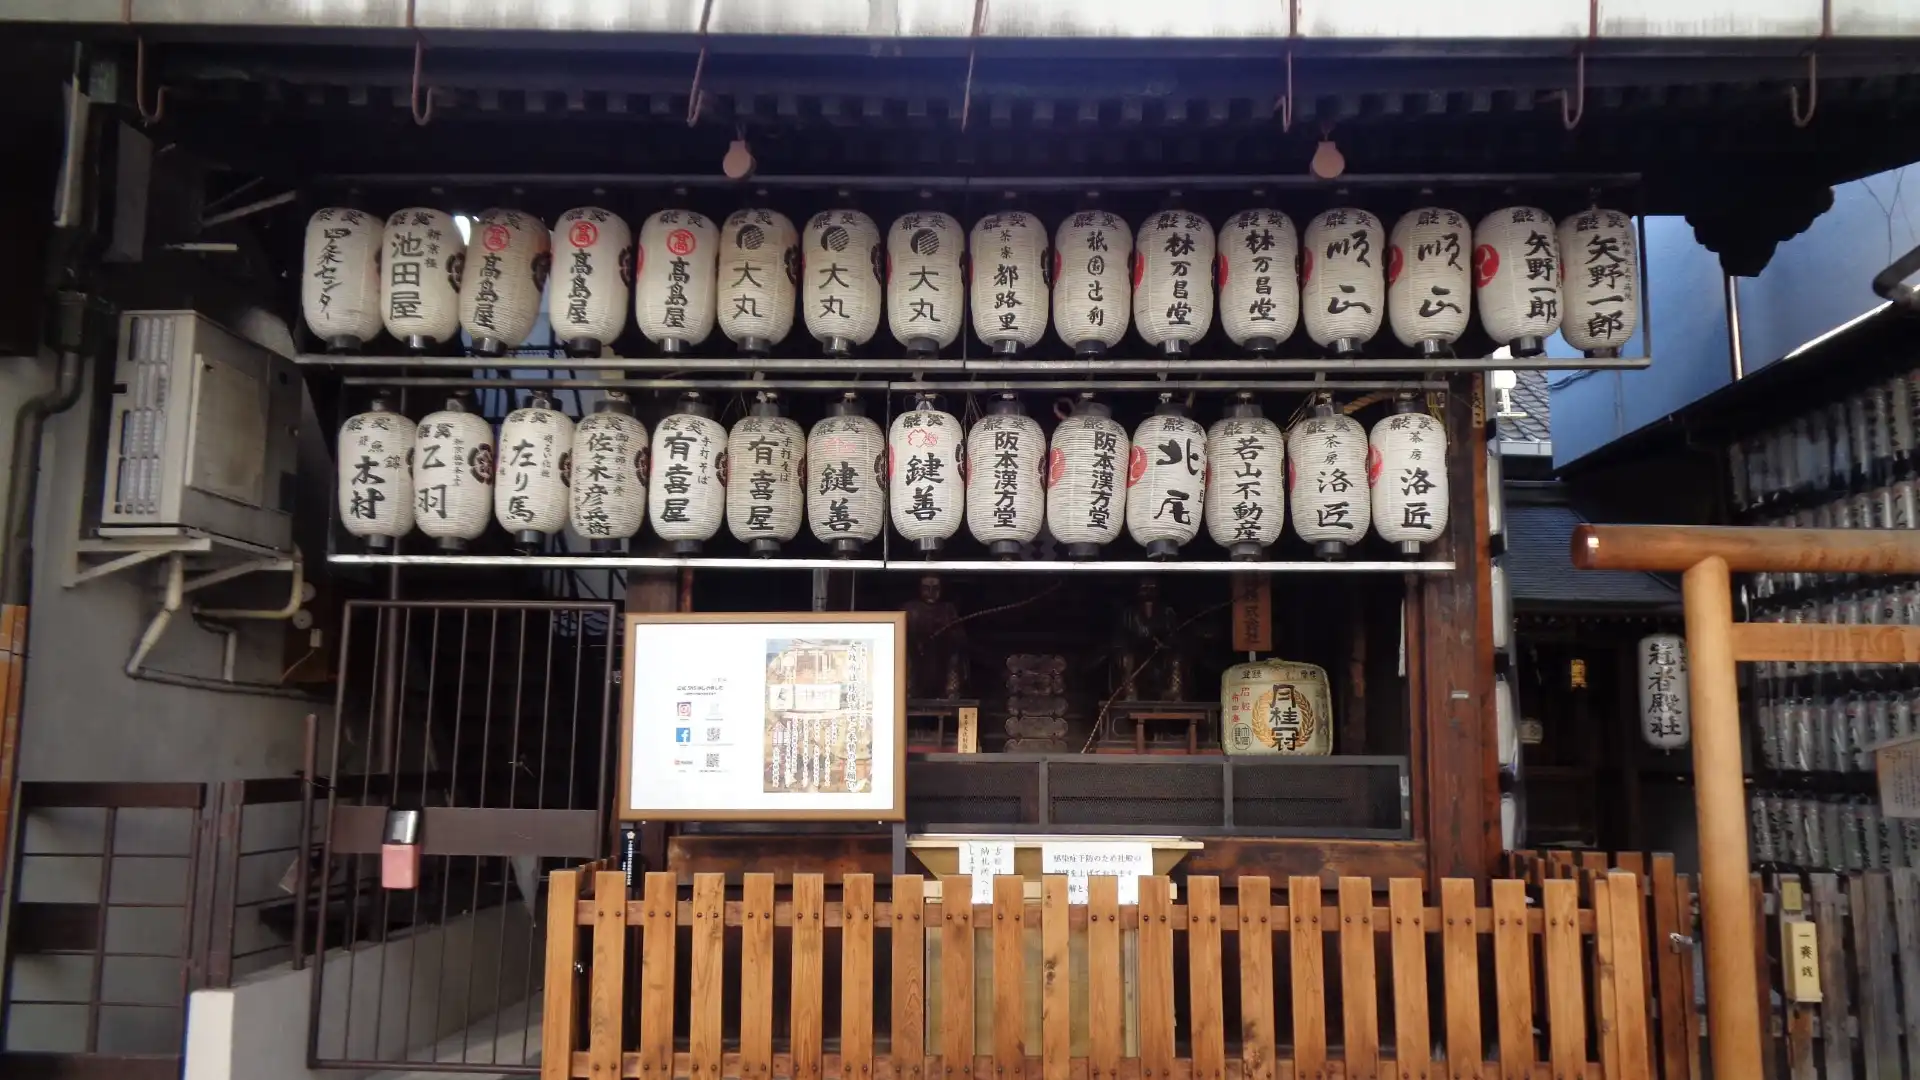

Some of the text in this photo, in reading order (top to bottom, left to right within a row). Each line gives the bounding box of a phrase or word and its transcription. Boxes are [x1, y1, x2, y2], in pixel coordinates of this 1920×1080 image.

[314, 227, 351, 320] 四条センター
[390, 232, 424, 321] 池田屋
[731, 261, 763, 319] 大丸
[819, 262, 850, 319] 大丸
[909, 265, 941, 322] 大丸
[1165, 233, 1196, 325] 林万昌堂
[1245, 230, 1276, 321] 林万昌堂
[1524, 230, 1557, 323] 矢野一郎
[1586, 235, 1626, 340] 矢野一郎
[350, 455, 386, 520] 木村
[418, 444, 447, 519] 乙羽
[506, 439, 536, 523] 左り馬
[660, 430, 697, 523] 有喜屋
[697, 436, 713, 485] 手打そば
[746, 435, 779, 531] 有喜屋
[779, 436, 793, 483] 手打そば
[819, 461, 860, 532] 鍵善
[905, 454, 945, 521] 鍵善
[993, 431, 1019, 529] 阪本漢方堂
[1087, 431, 1116, 530] 阪本漢方堂
[1153, 438, 1200, 526] 北尾
[1232, 436, 1264, 541] 若山不動産
[1269, 684, 1299, 750] 月桂冠
